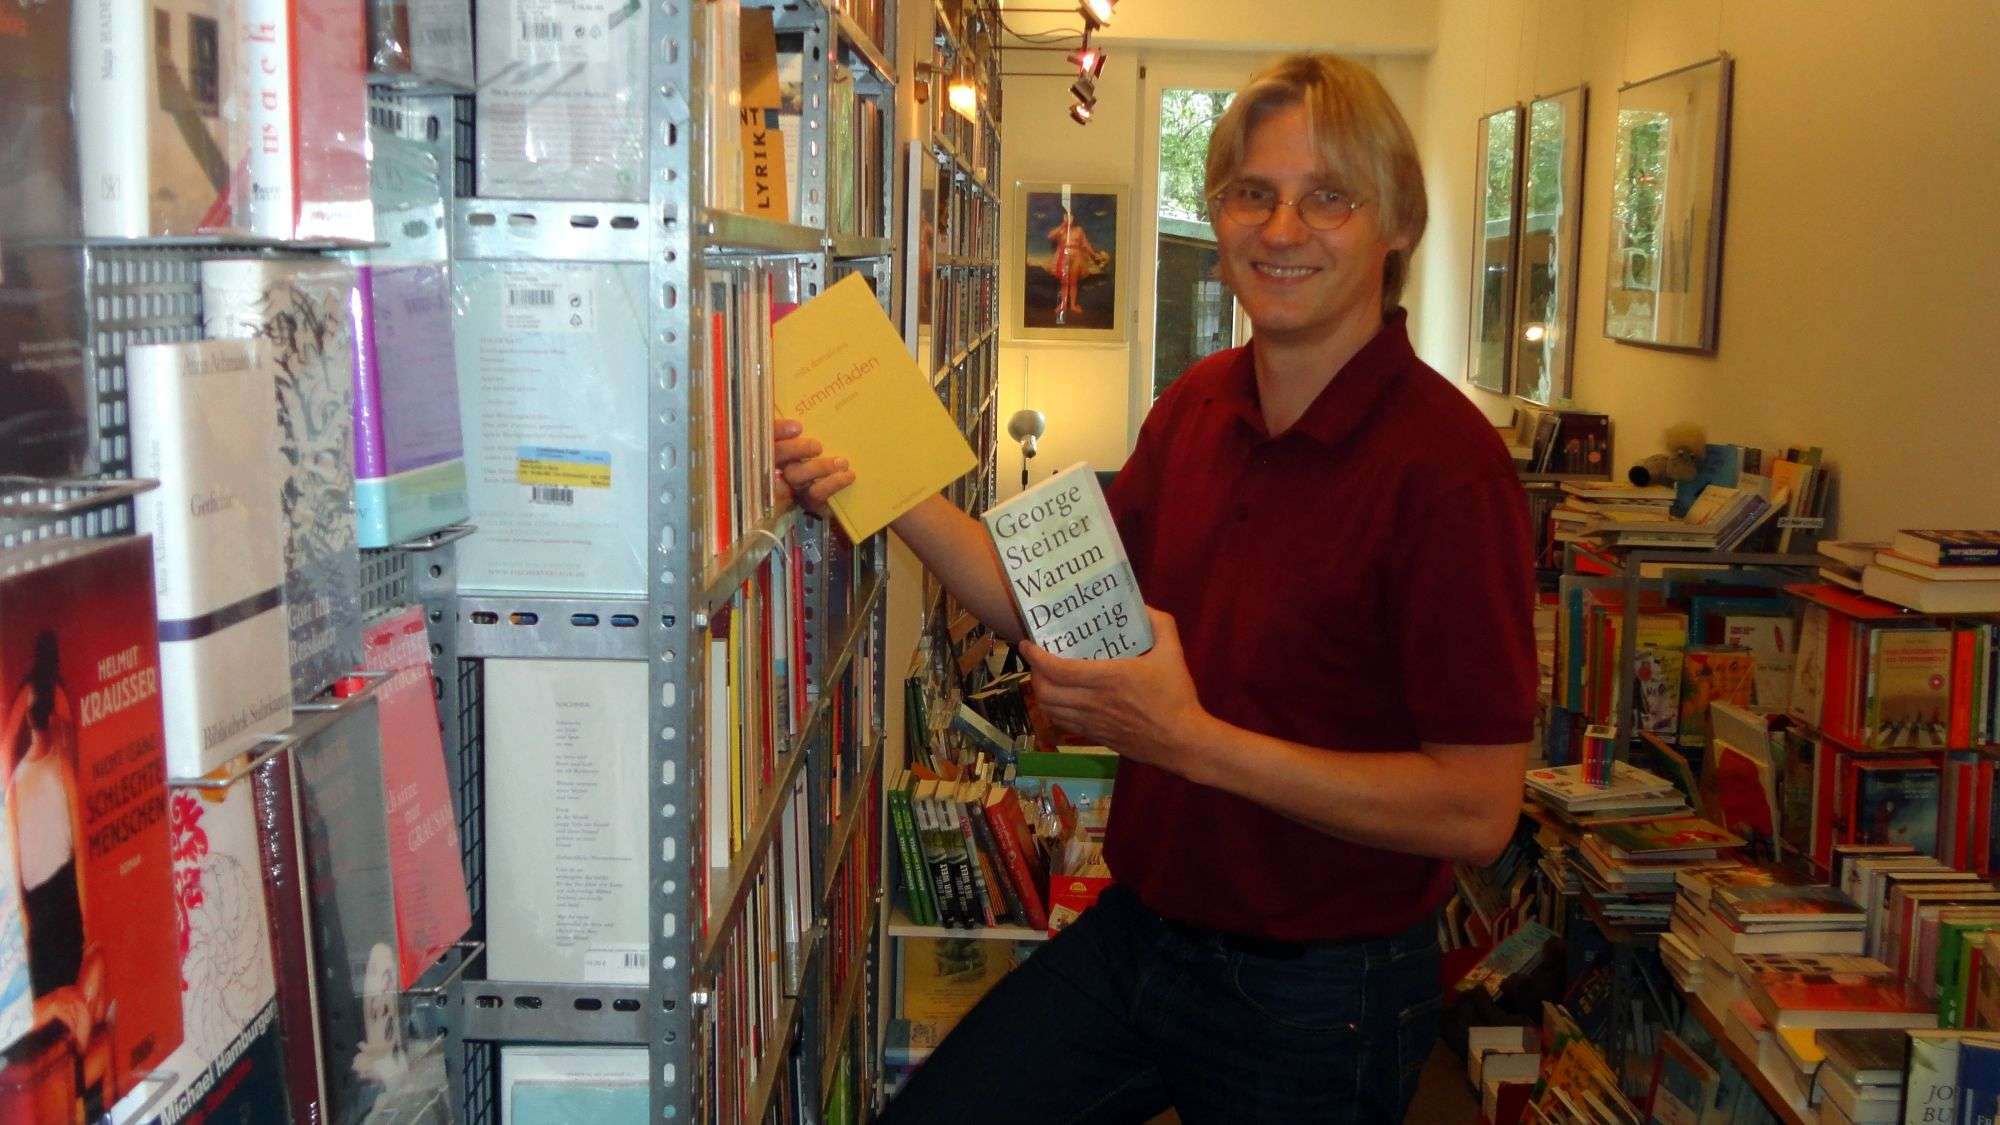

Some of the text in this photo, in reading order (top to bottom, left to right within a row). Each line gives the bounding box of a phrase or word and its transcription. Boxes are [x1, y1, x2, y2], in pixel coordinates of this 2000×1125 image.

[752, 130, 771, 209] LYRIK
[995, 486, 1082, 539] George
[1006, 514, 1094, 570] Steiner
[1014, 545, 1104, 598] Warum
[1028, 573, 1119, 630] Denken
[1041, 602, 1129, 654] traurig
[97, 645, 139, 681] HELMUT
[80, 666, 157, 728] KRAUSSER
[88, 796, 166, 859] MENSCHEN
[161, 999, 278, 1125] Michael Hamburger
